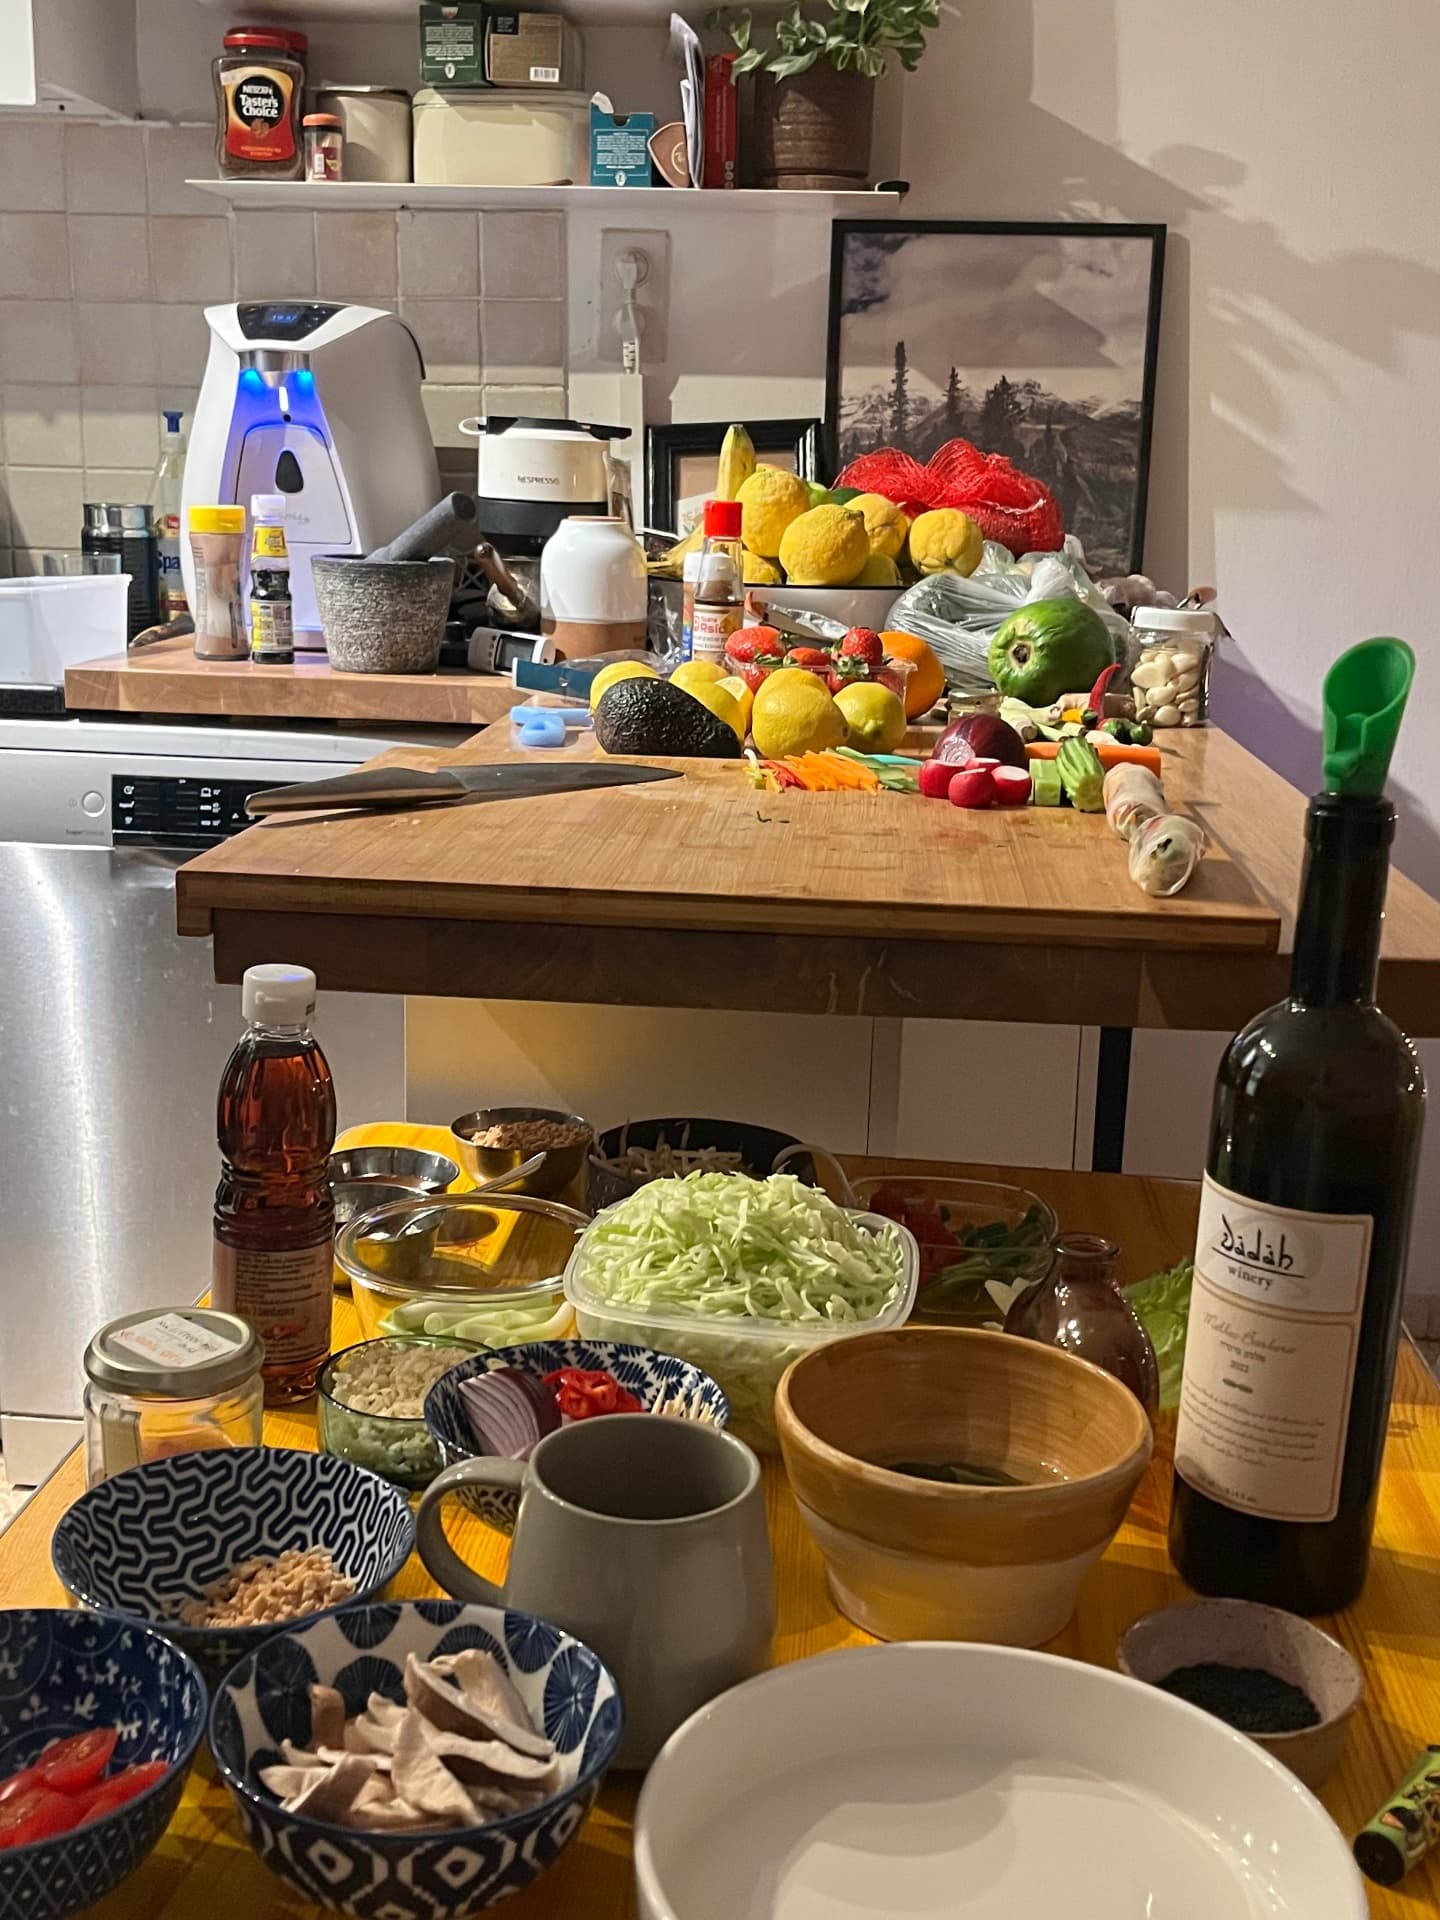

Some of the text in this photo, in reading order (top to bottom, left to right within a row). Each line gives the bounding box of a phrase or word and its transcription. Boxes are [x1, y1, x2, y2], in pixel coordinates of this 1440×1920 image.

[239, 94, 279, 108] Taster's
[242, 105, 280, 118] Choice
[517, 475, 561, 486] NESPRESSO
[1228, 1266, 1275, 1291] winery
